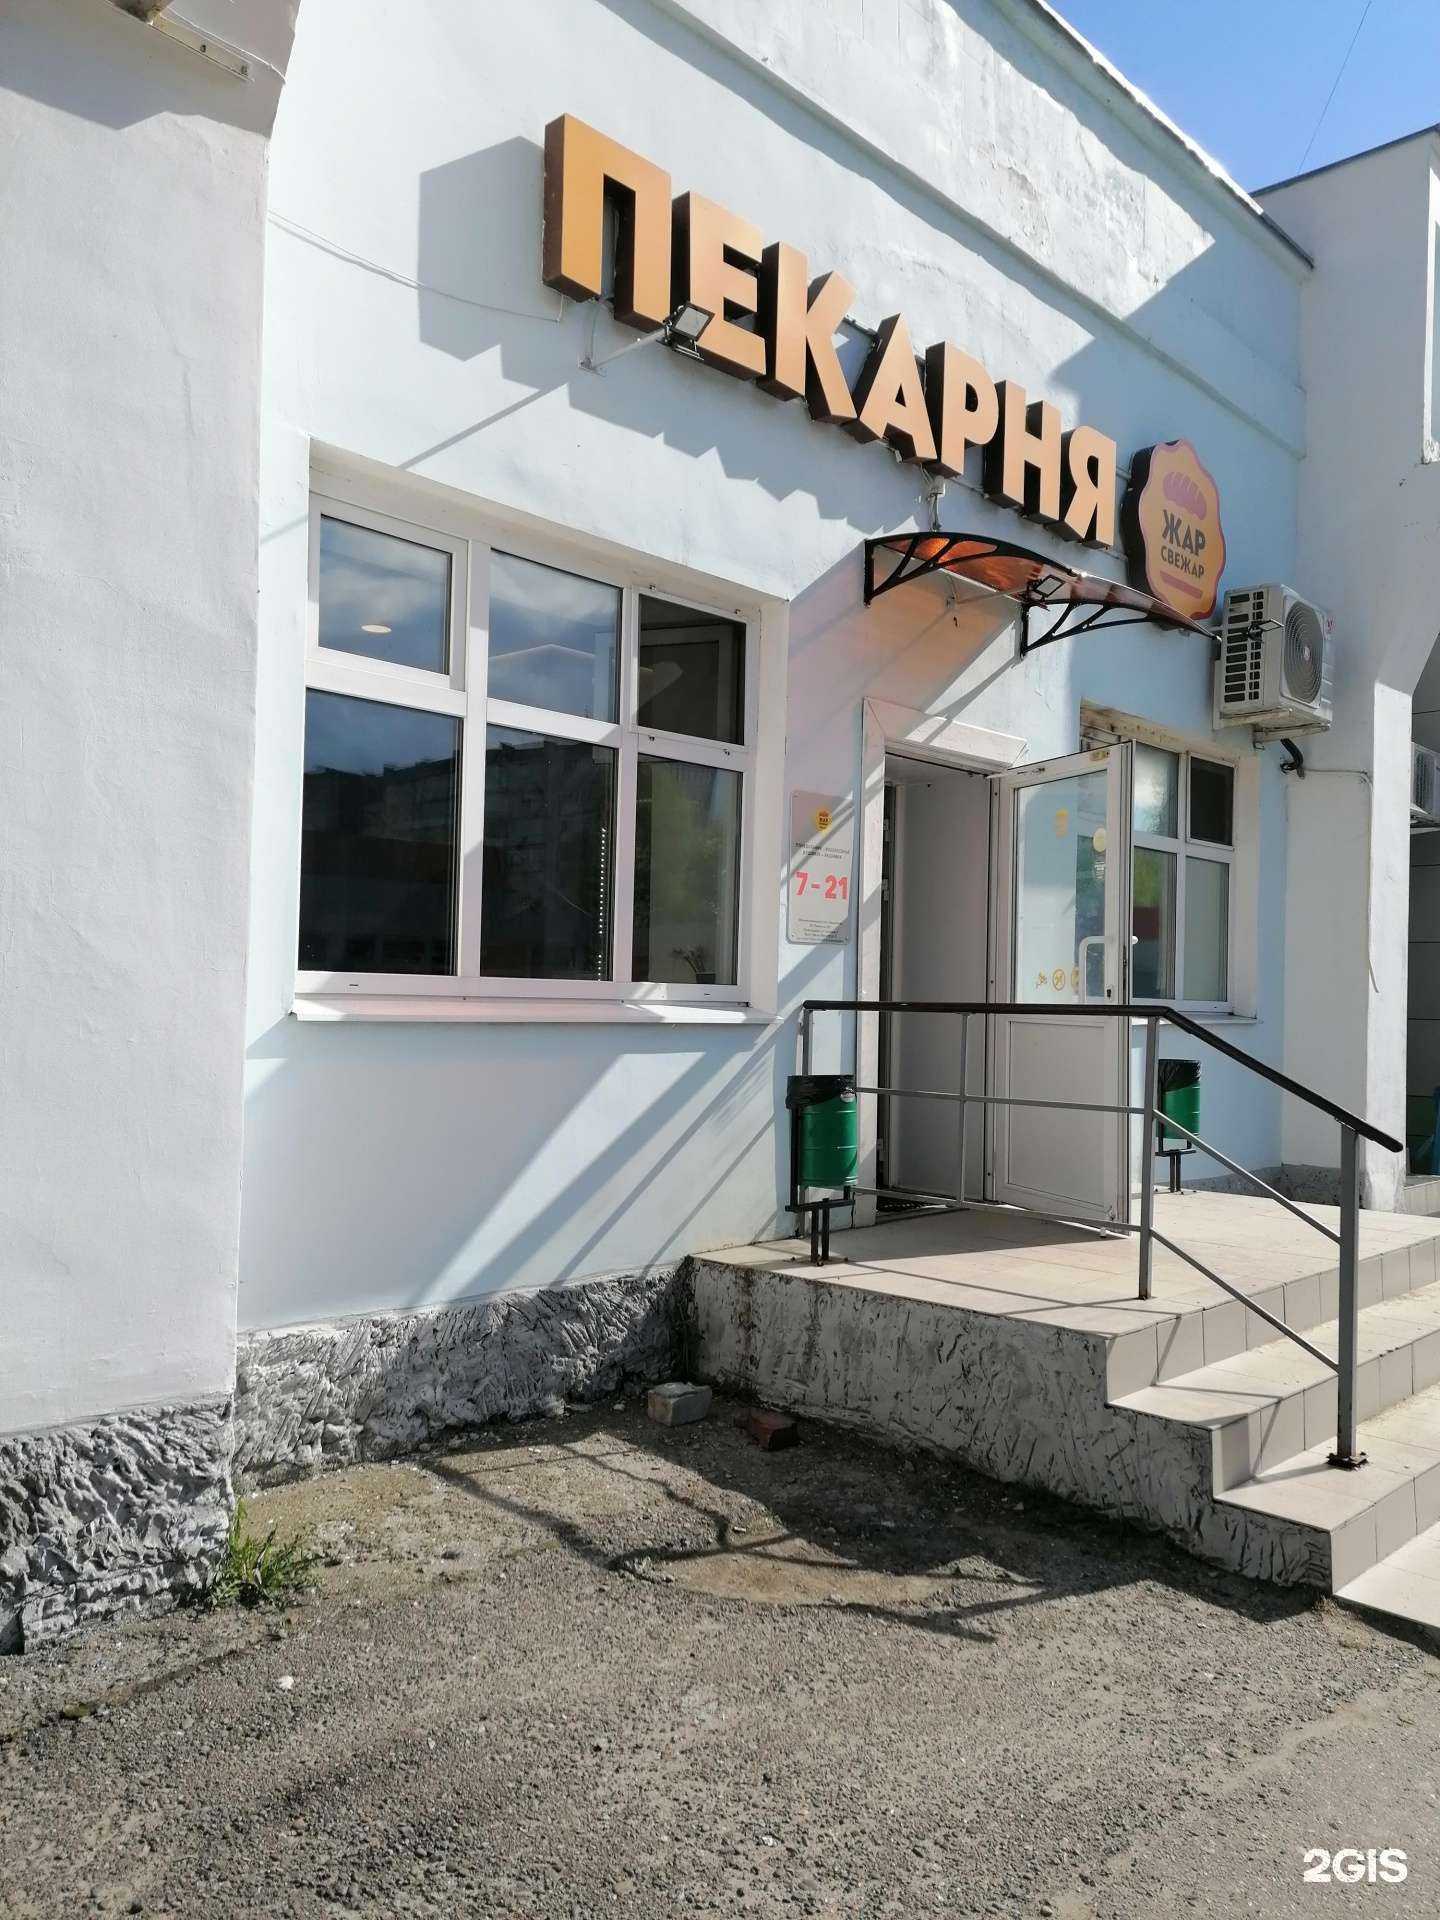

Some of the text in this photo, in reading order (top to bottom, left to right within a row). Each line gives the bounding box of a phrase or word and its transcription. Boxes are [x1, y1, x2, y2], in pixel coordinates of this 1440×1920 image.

[545, 113, 1117, 548] ПЕКАРНЯ
[1161, 508, 1206, 557] ЖАР
[1160, 545, 1206, 580] СВЕЖАР
